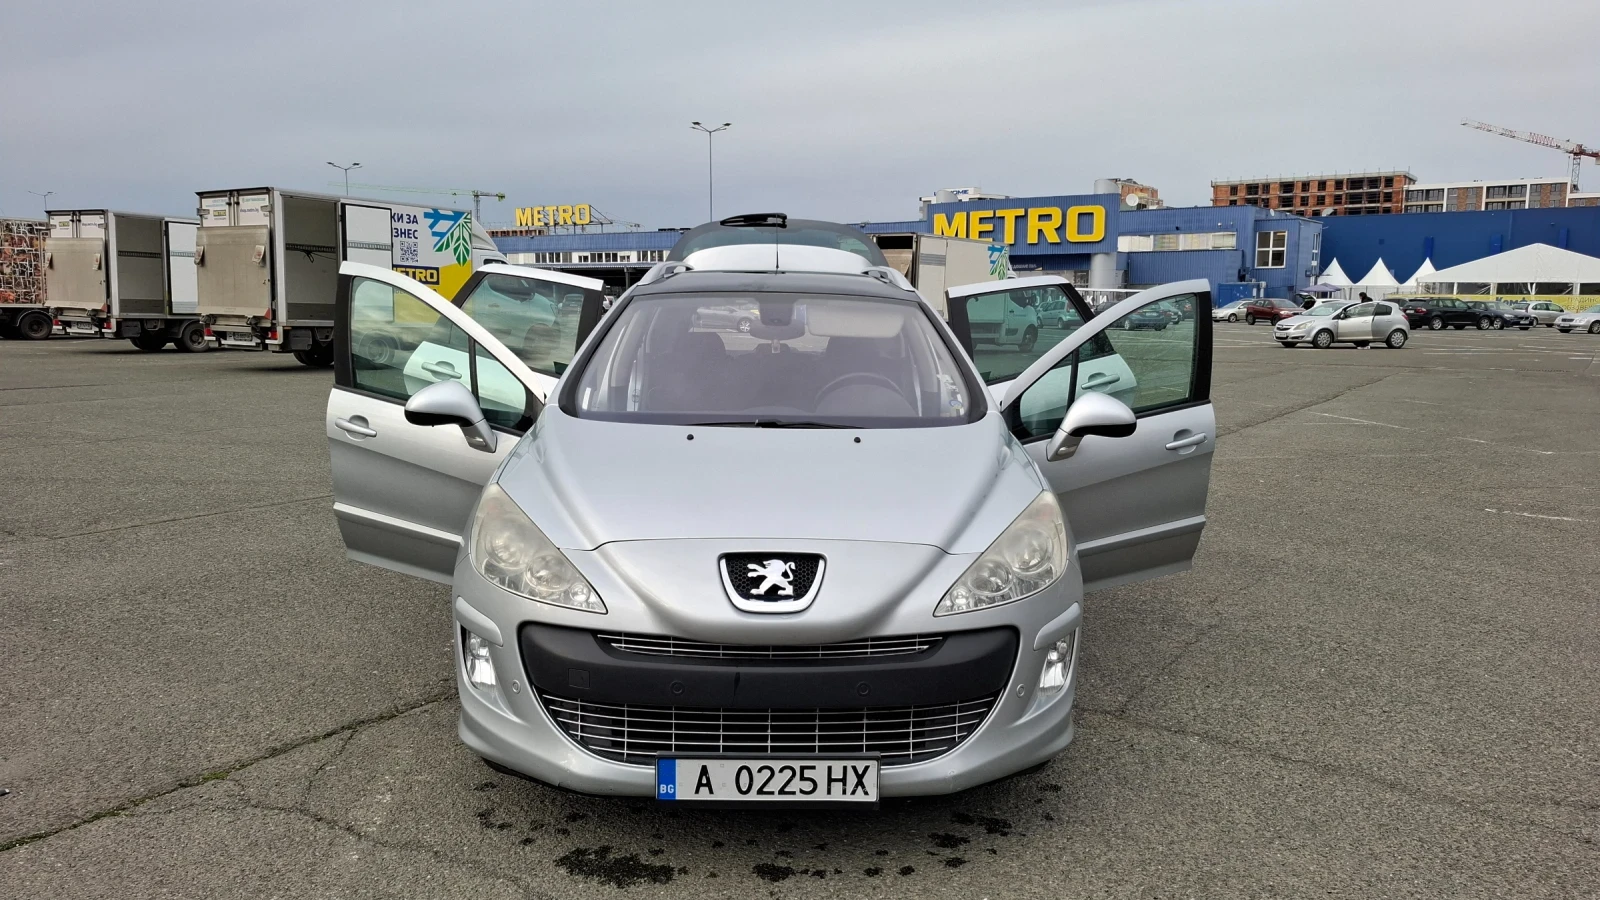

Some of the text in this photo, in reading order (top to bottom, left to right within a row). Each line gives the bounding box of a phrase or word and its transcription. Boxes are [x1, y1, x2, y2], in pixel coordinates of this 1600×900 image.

[406, 213, 418, 225] ЗА
[515, 204, 591, 226] METRO
[933, 205, 1106, 244] METRO
[393, 267, 438, 282] ETRO
[659, 784, 675, 794] BG
[694, 764, 870, 796] A 0225 HX
